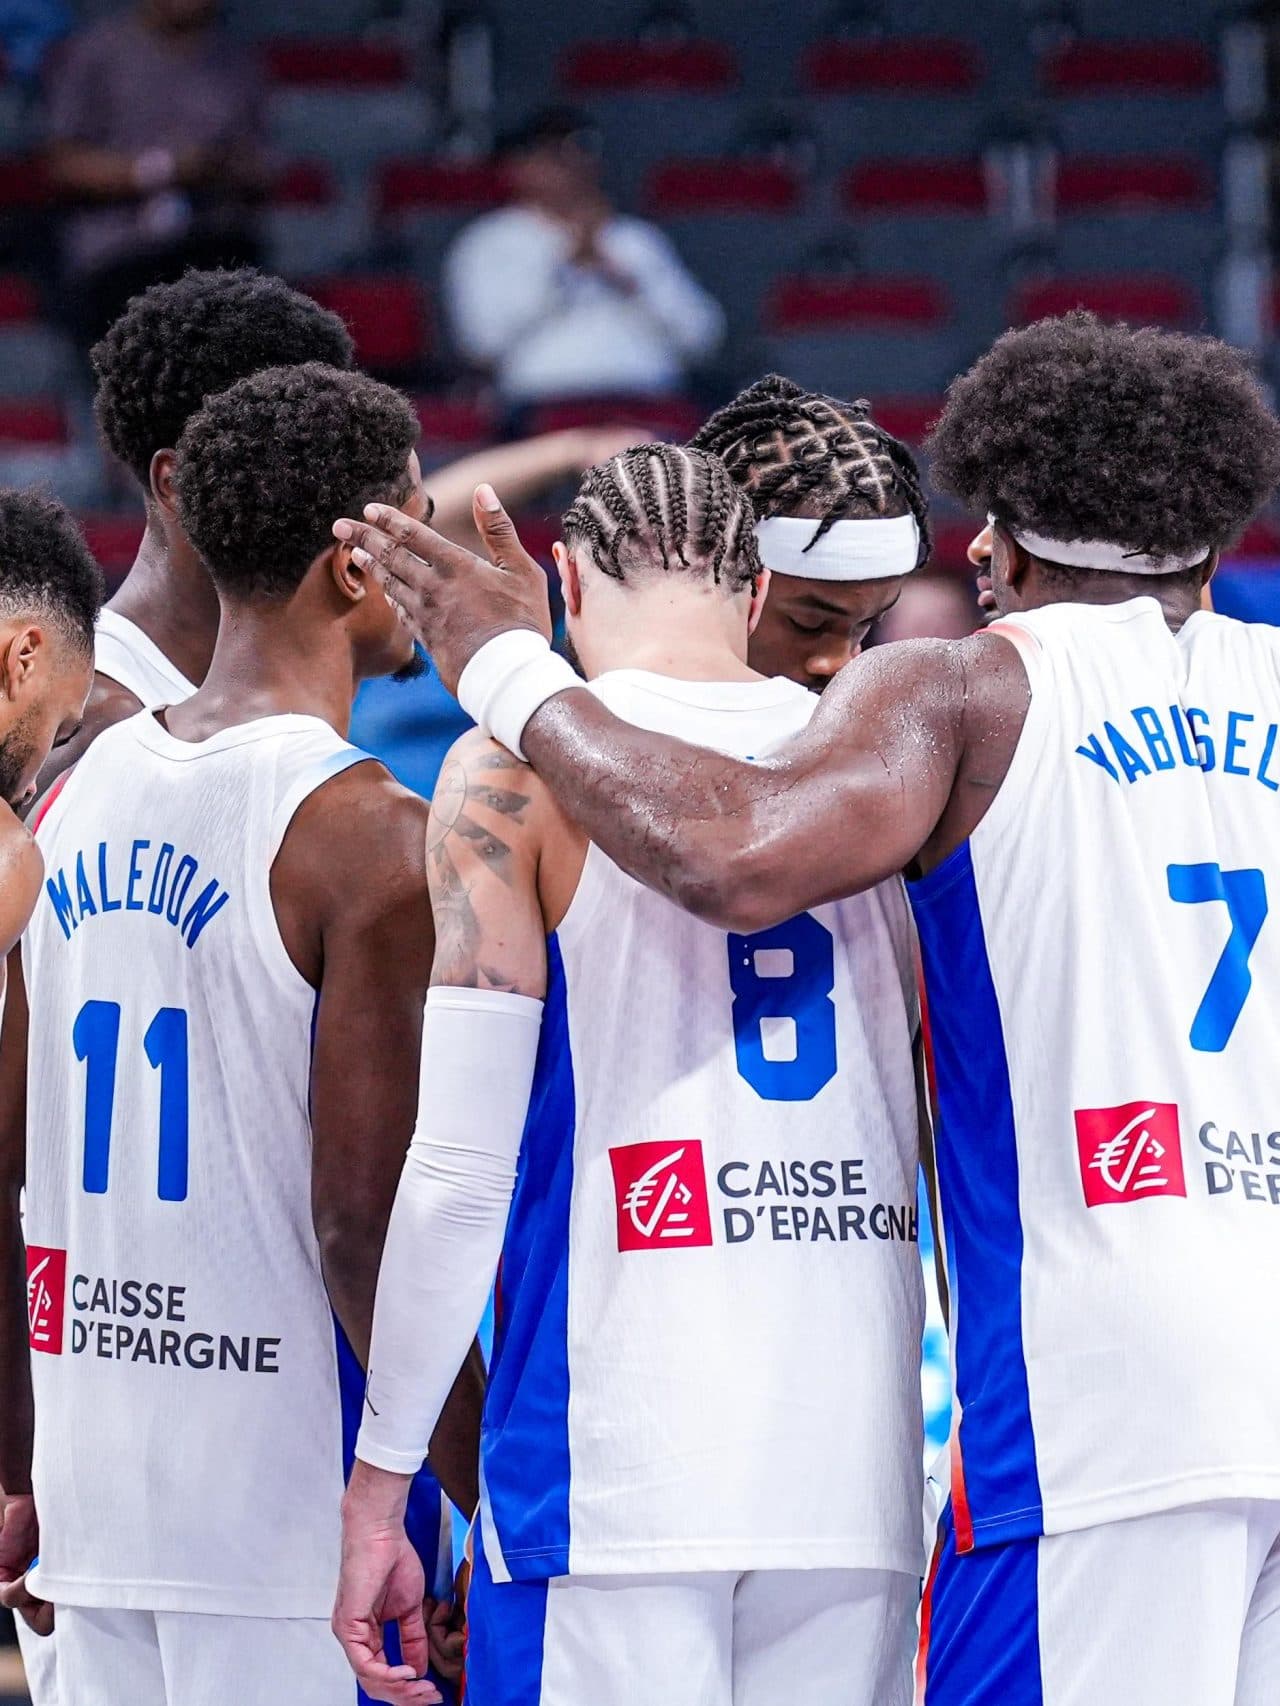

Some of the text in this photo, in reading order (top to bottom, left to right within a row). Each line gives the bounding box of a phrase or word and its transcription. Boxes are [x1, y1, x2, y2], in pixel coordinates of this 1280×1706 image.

[47, 839, 229, 949] MALEDON
[727, 911, 837, 1101] 8
[1167, 863, 1268, 1053] 7
[73, 1000, 188, 1201] 11
[717, 1159, 867, 1198] CAISSE
[71, 1320, 282, 1374] D'EPARGNE
[72, 1274, 186, 1322] CAISSE
